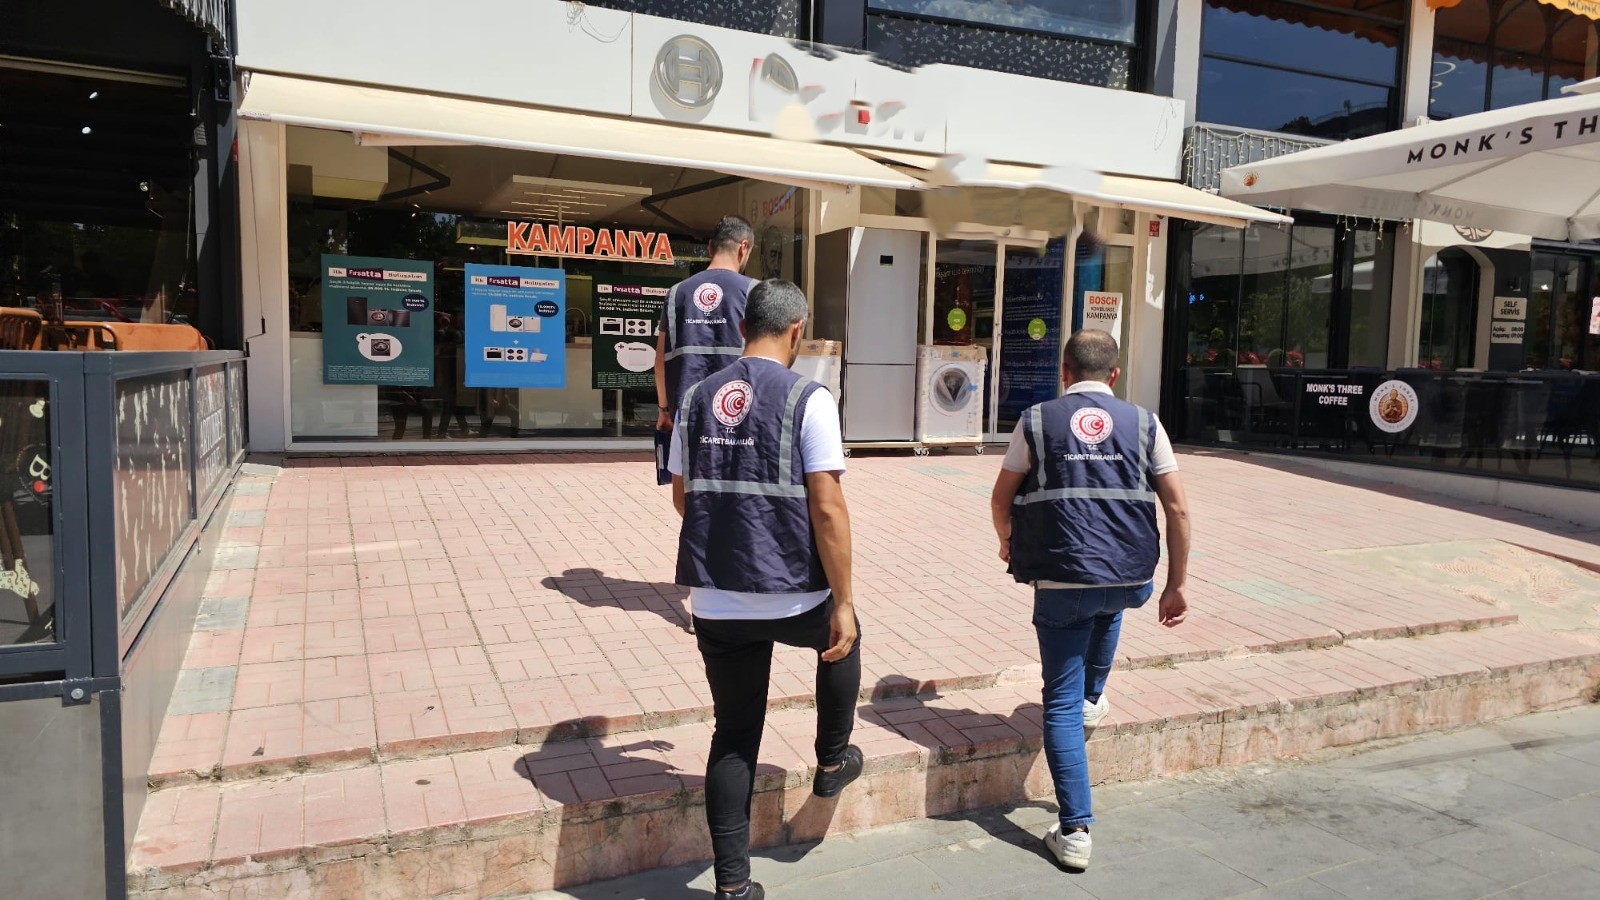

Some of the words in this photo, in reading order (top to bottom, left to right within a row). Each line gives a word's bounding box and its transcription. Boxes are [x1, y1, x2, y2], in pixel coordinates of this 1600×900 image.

[1407, 126, 1533, 164] MONK'S
[507, 221, 673, 262] KAMPANYA
[348, 269, 382, 279] Fırsatta
[488, 277, 518, 286] Fırsatta
[1089, 296, 1117, 305] BOSCH
[1503, 300, 1518, 308] SELF
[1086, 312, 1117, 320] KAMPANYA
[1306, 383, 1336, 393] MONK'S
[1337, 384, 1364, 394] THREE
[1318, 395, 1349, 406] COFFEE
[1063, 453, 1090, 461] TİCARET
[1090, 453, 1124, 461] BAKANLIĞI
